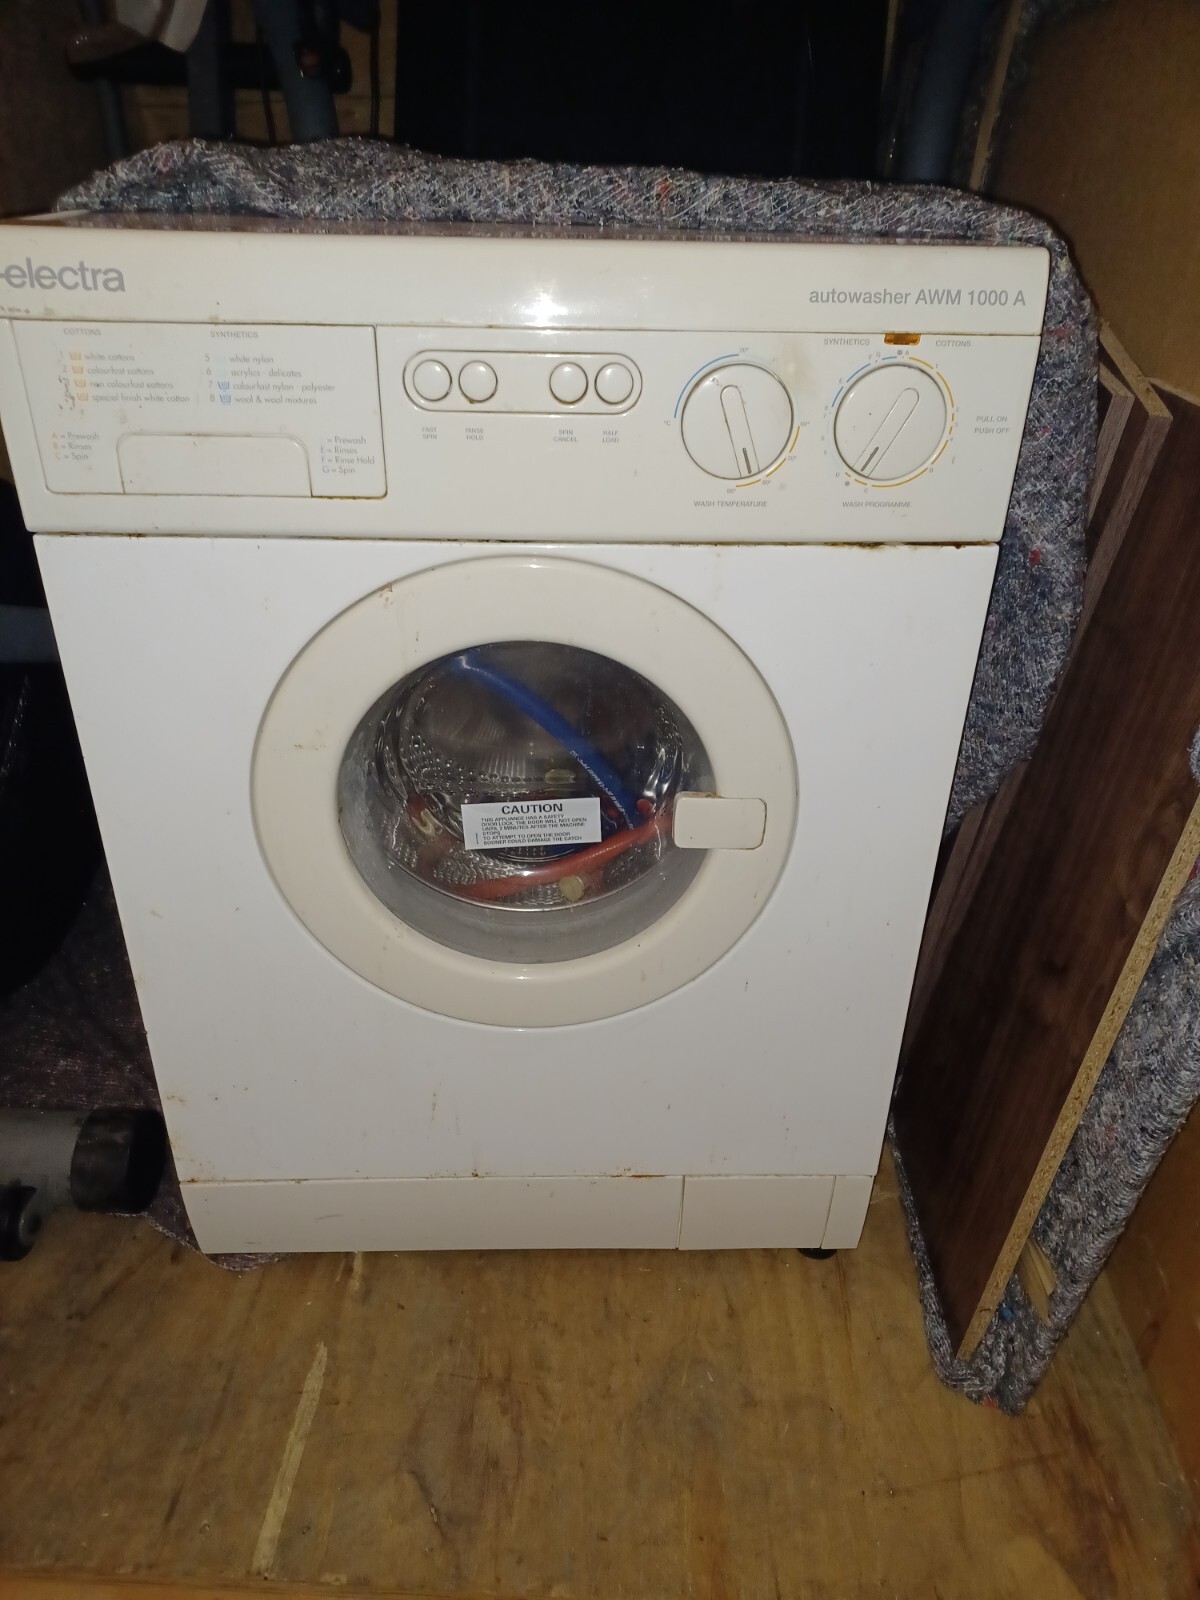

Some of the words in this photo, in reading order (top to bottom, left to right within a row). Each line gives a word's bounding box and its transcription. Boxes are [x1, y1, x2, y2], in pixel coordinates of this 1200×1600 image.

[2, 257, 125, 292] electra
[809, 288, 911, 304] autowasher
[915, 289, 962, 305] AWM
[968, 290, 1008, 305] 1000
[1013, 291, 1026, 305] A
[229, 354, 249, 363] white
[253, 356, 273, 366] nylon
[88, 367, 125, 375] colourfast
[232, 369, 260, 379] acrylics
[269, 369, 301, 377] delicates
[107, 380, 144, 388] colourfast
[147, 381, 173, 389] cottons
[233, 382, 270, 390] colourfast
[273, 383, 293, 393] nylon
[301, 383, 335, 395] polyester
[92, 393, 118, 403] special
[144, 394, 164, 402] white
[167, 395, 190, 403] cotton
[68, 432, 100, 440] Prewash
[335, 435, 367, 444] Prewash
[68, 442, 92, 450] Rinses
[334, 446, 358, 454] Rinses
[71, 452, 89, 461] Spin
[335, 456, 354, 464] Rinse
[357, 456, 375, 464] Hold
[339, 466, 355, 475] Spin
[502, 803, 563, 815] CAUTION
